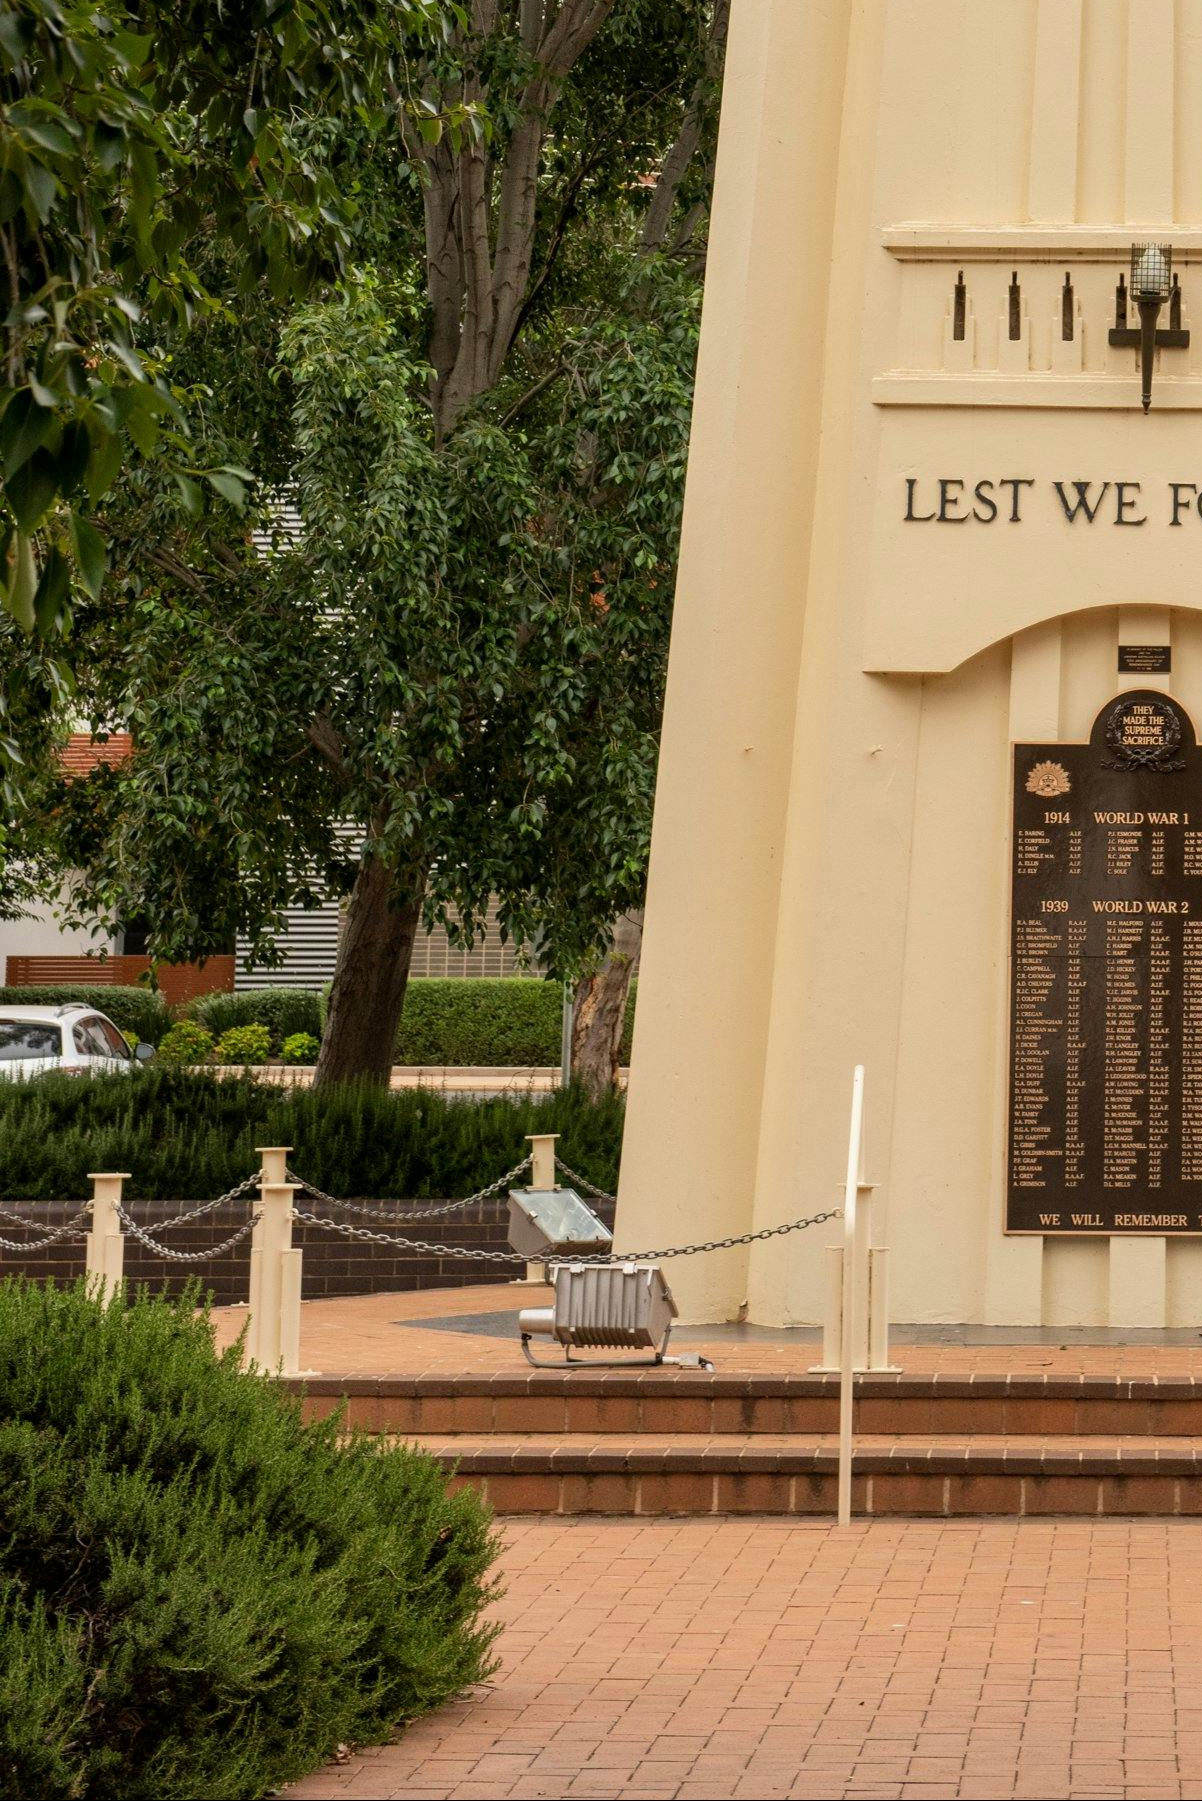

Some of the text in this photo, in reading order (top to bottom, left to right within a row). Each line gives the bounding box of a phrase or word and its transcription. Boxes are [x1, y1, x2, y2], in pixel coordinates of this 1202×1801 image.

[903, 478, 1035, 523] LEST
[1053, 481, 1148, 526] WE
[1133, 706, 1154, 715] THEY
[1123, 716, 1164, 725] MADE THE
[1125, 726, 1162, 734] SUPREME
[1122, 736, 1164, 745] SACRIFICE
[1044, 812, 1070, 824] 1914
[1094, 812, 1144, 824] WORLD
[1147, 813, 1179, 824] WAR
[1183, 813, 1189, 824] 1
[1041, 901, 1068, 912] 1939
[1093, 901, 1143, 913] WORLD
[1146, 901, 1178, 913] WAR
[1181, 902, 1188, 913] 2
[1039, 1214, 1060, 1225] WE
[1071, 1214, 1104, 1225] WILL
[1114, 1215, 1187, 1226] REMEMBER
